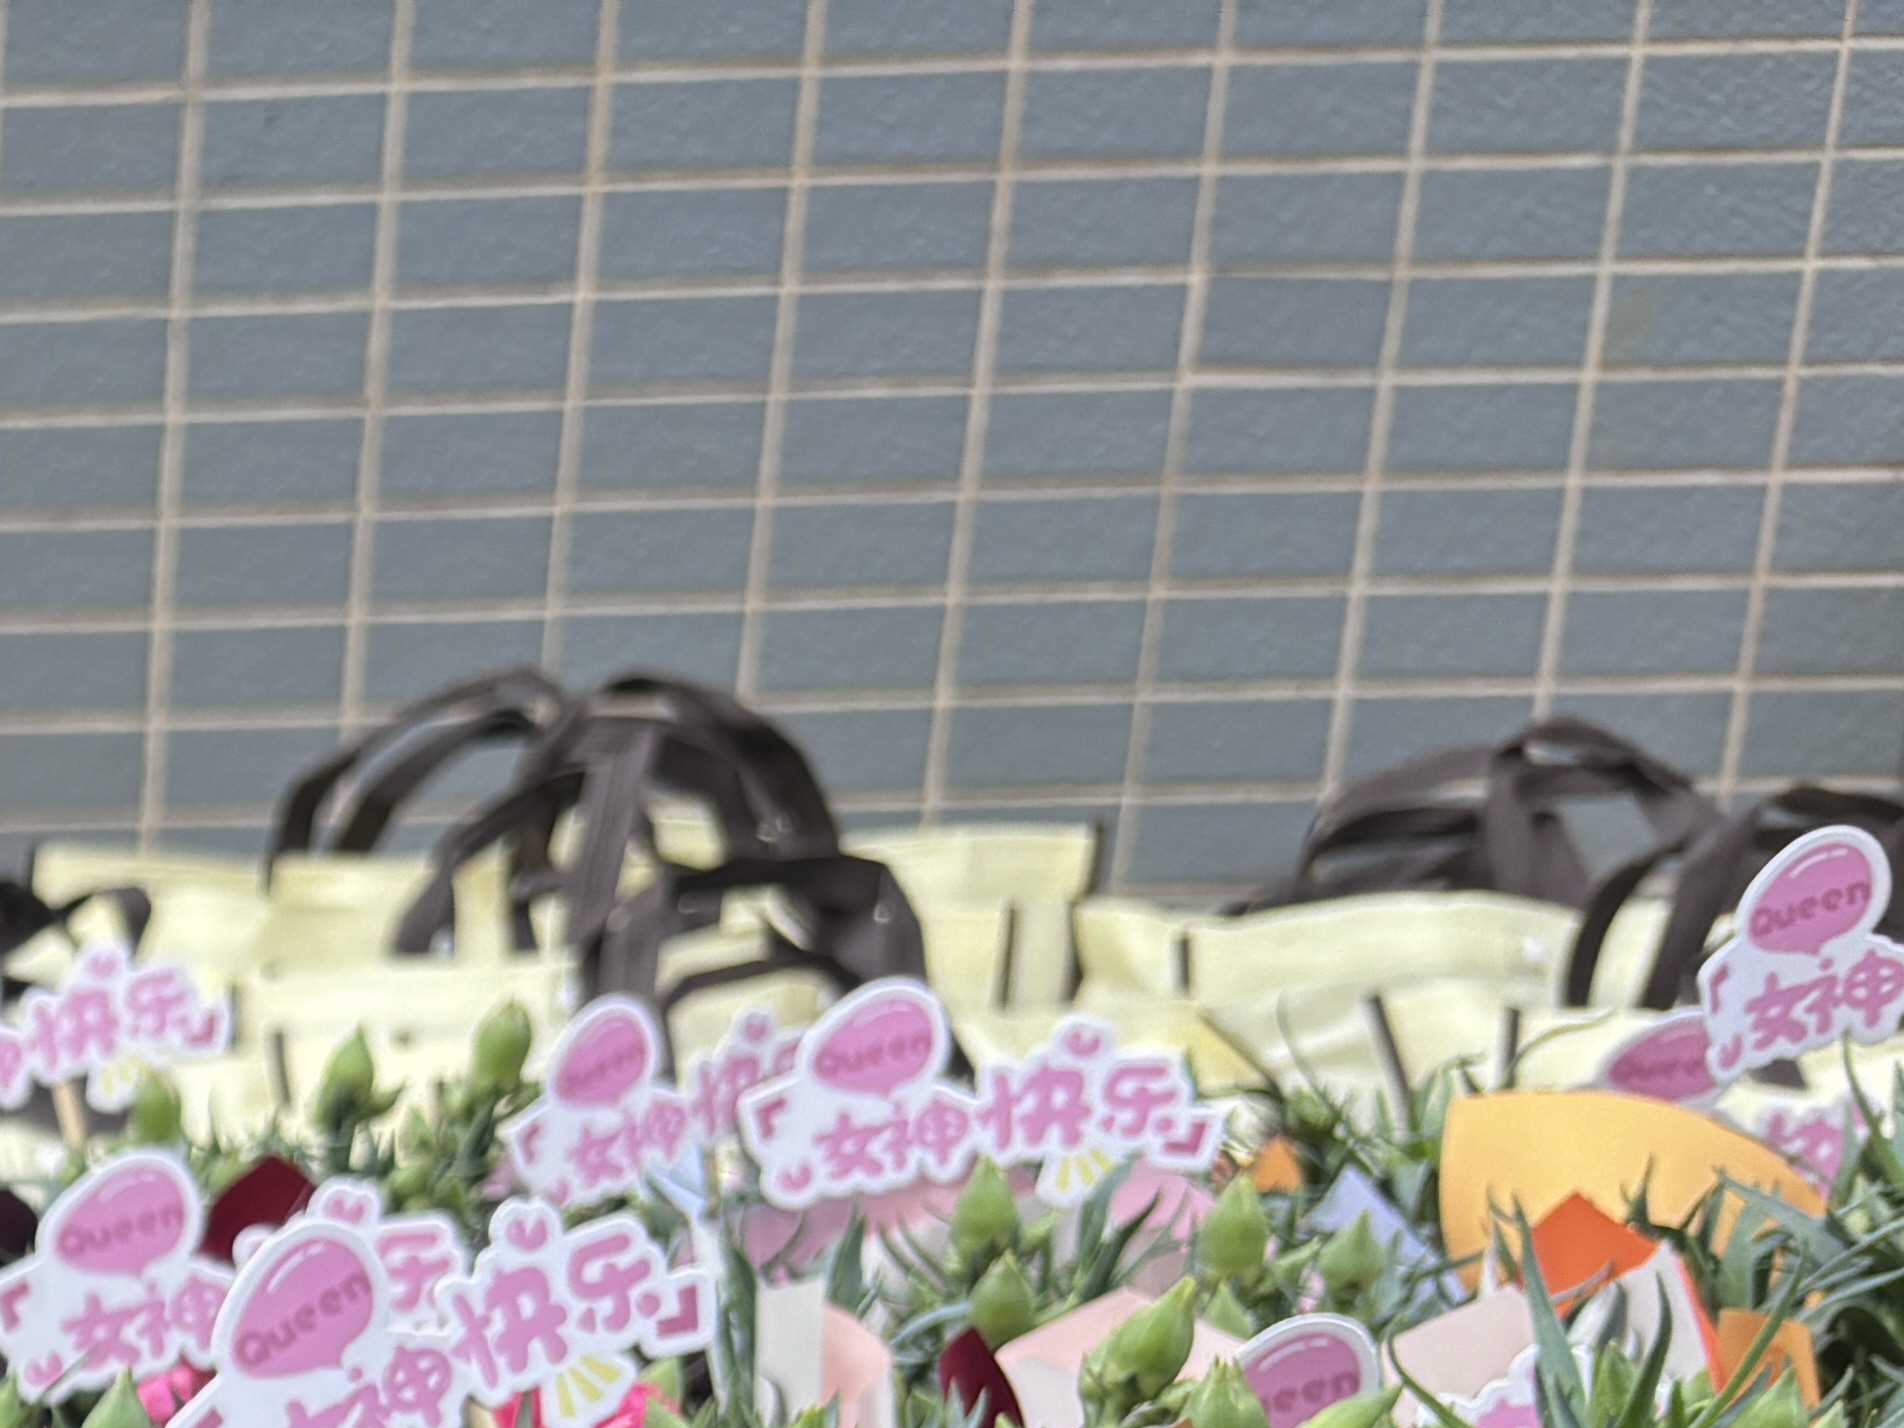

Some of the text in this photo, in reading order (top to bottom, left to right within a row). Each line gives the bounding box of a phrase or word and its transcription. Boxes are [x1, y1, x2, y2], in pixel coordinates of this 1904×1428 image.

[1753, 882, 1872, 934] Queen
[815, 1032, 933, 1074] Queen
[59, 1209, 184, 1256] Queen
[237, 1274, 372, 1359] Queen
